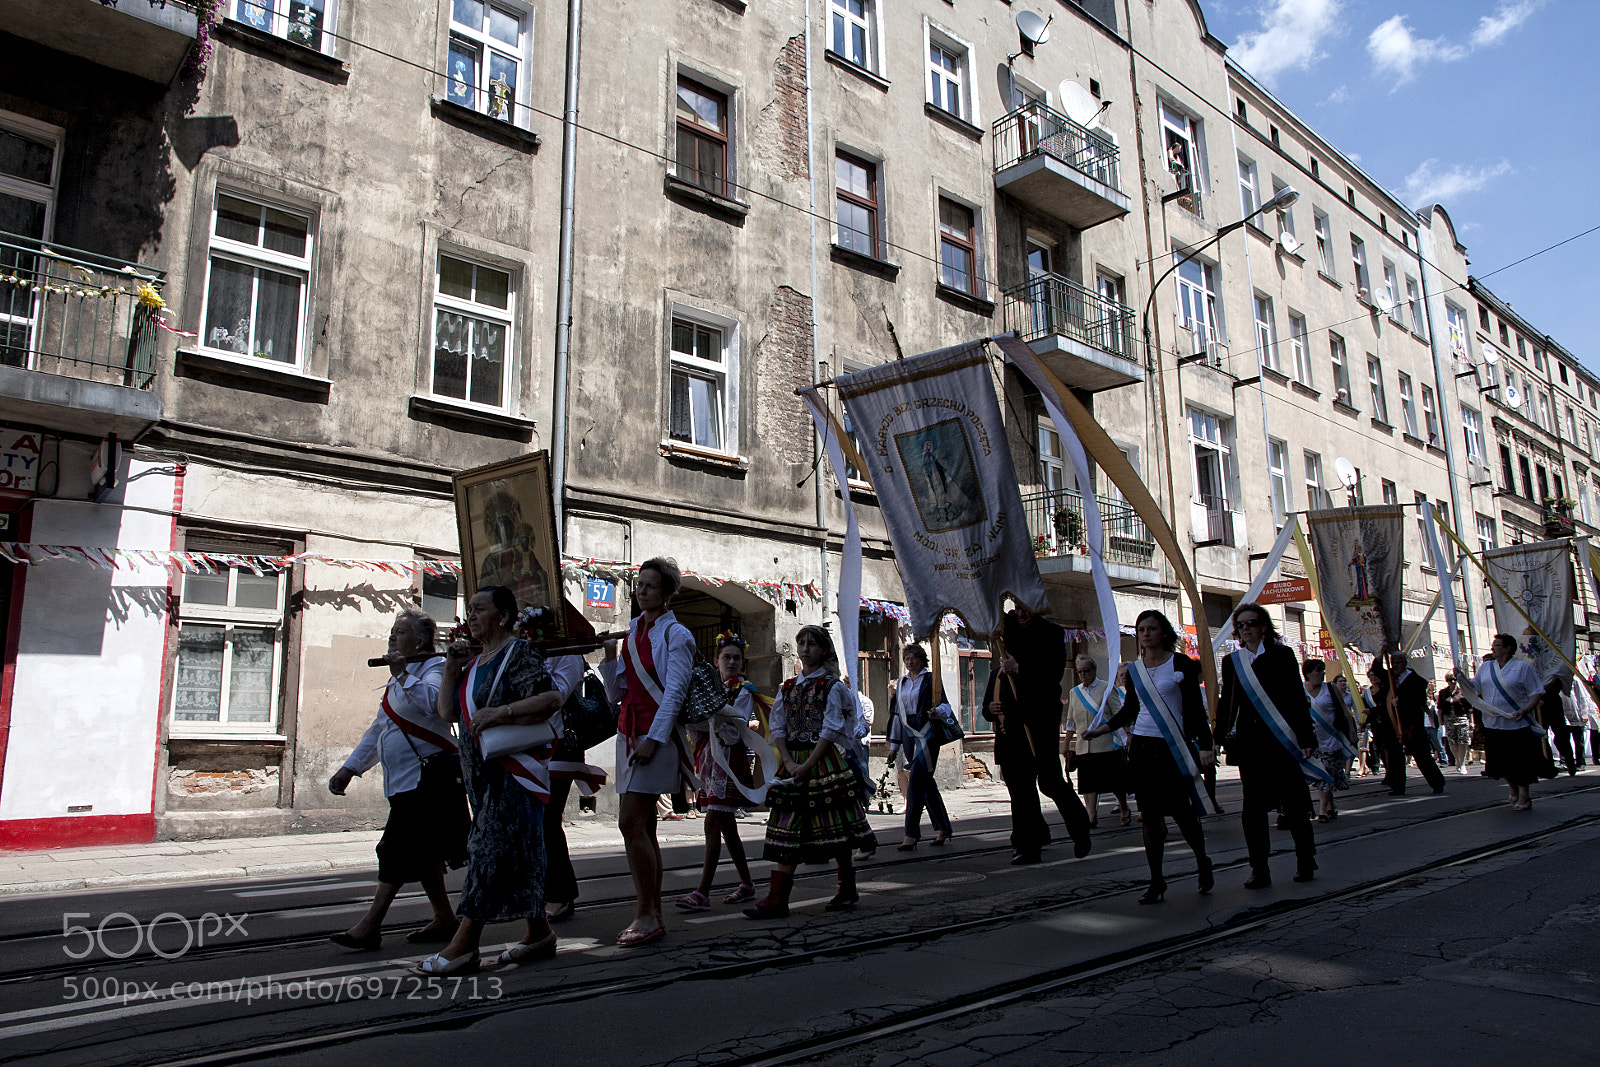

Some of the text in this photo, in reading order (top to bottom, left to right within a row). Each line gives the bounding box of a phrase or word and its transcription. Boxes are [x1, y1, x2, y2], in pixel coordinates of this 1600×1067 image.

[877, 413, 895, 457] MARYJO
[892, 402, 911, 417] BEZ
[964, 543, 983, 558] ZA
[985, 512, 1007, 543] NAMI
[593, 584, 608, 601] 57
